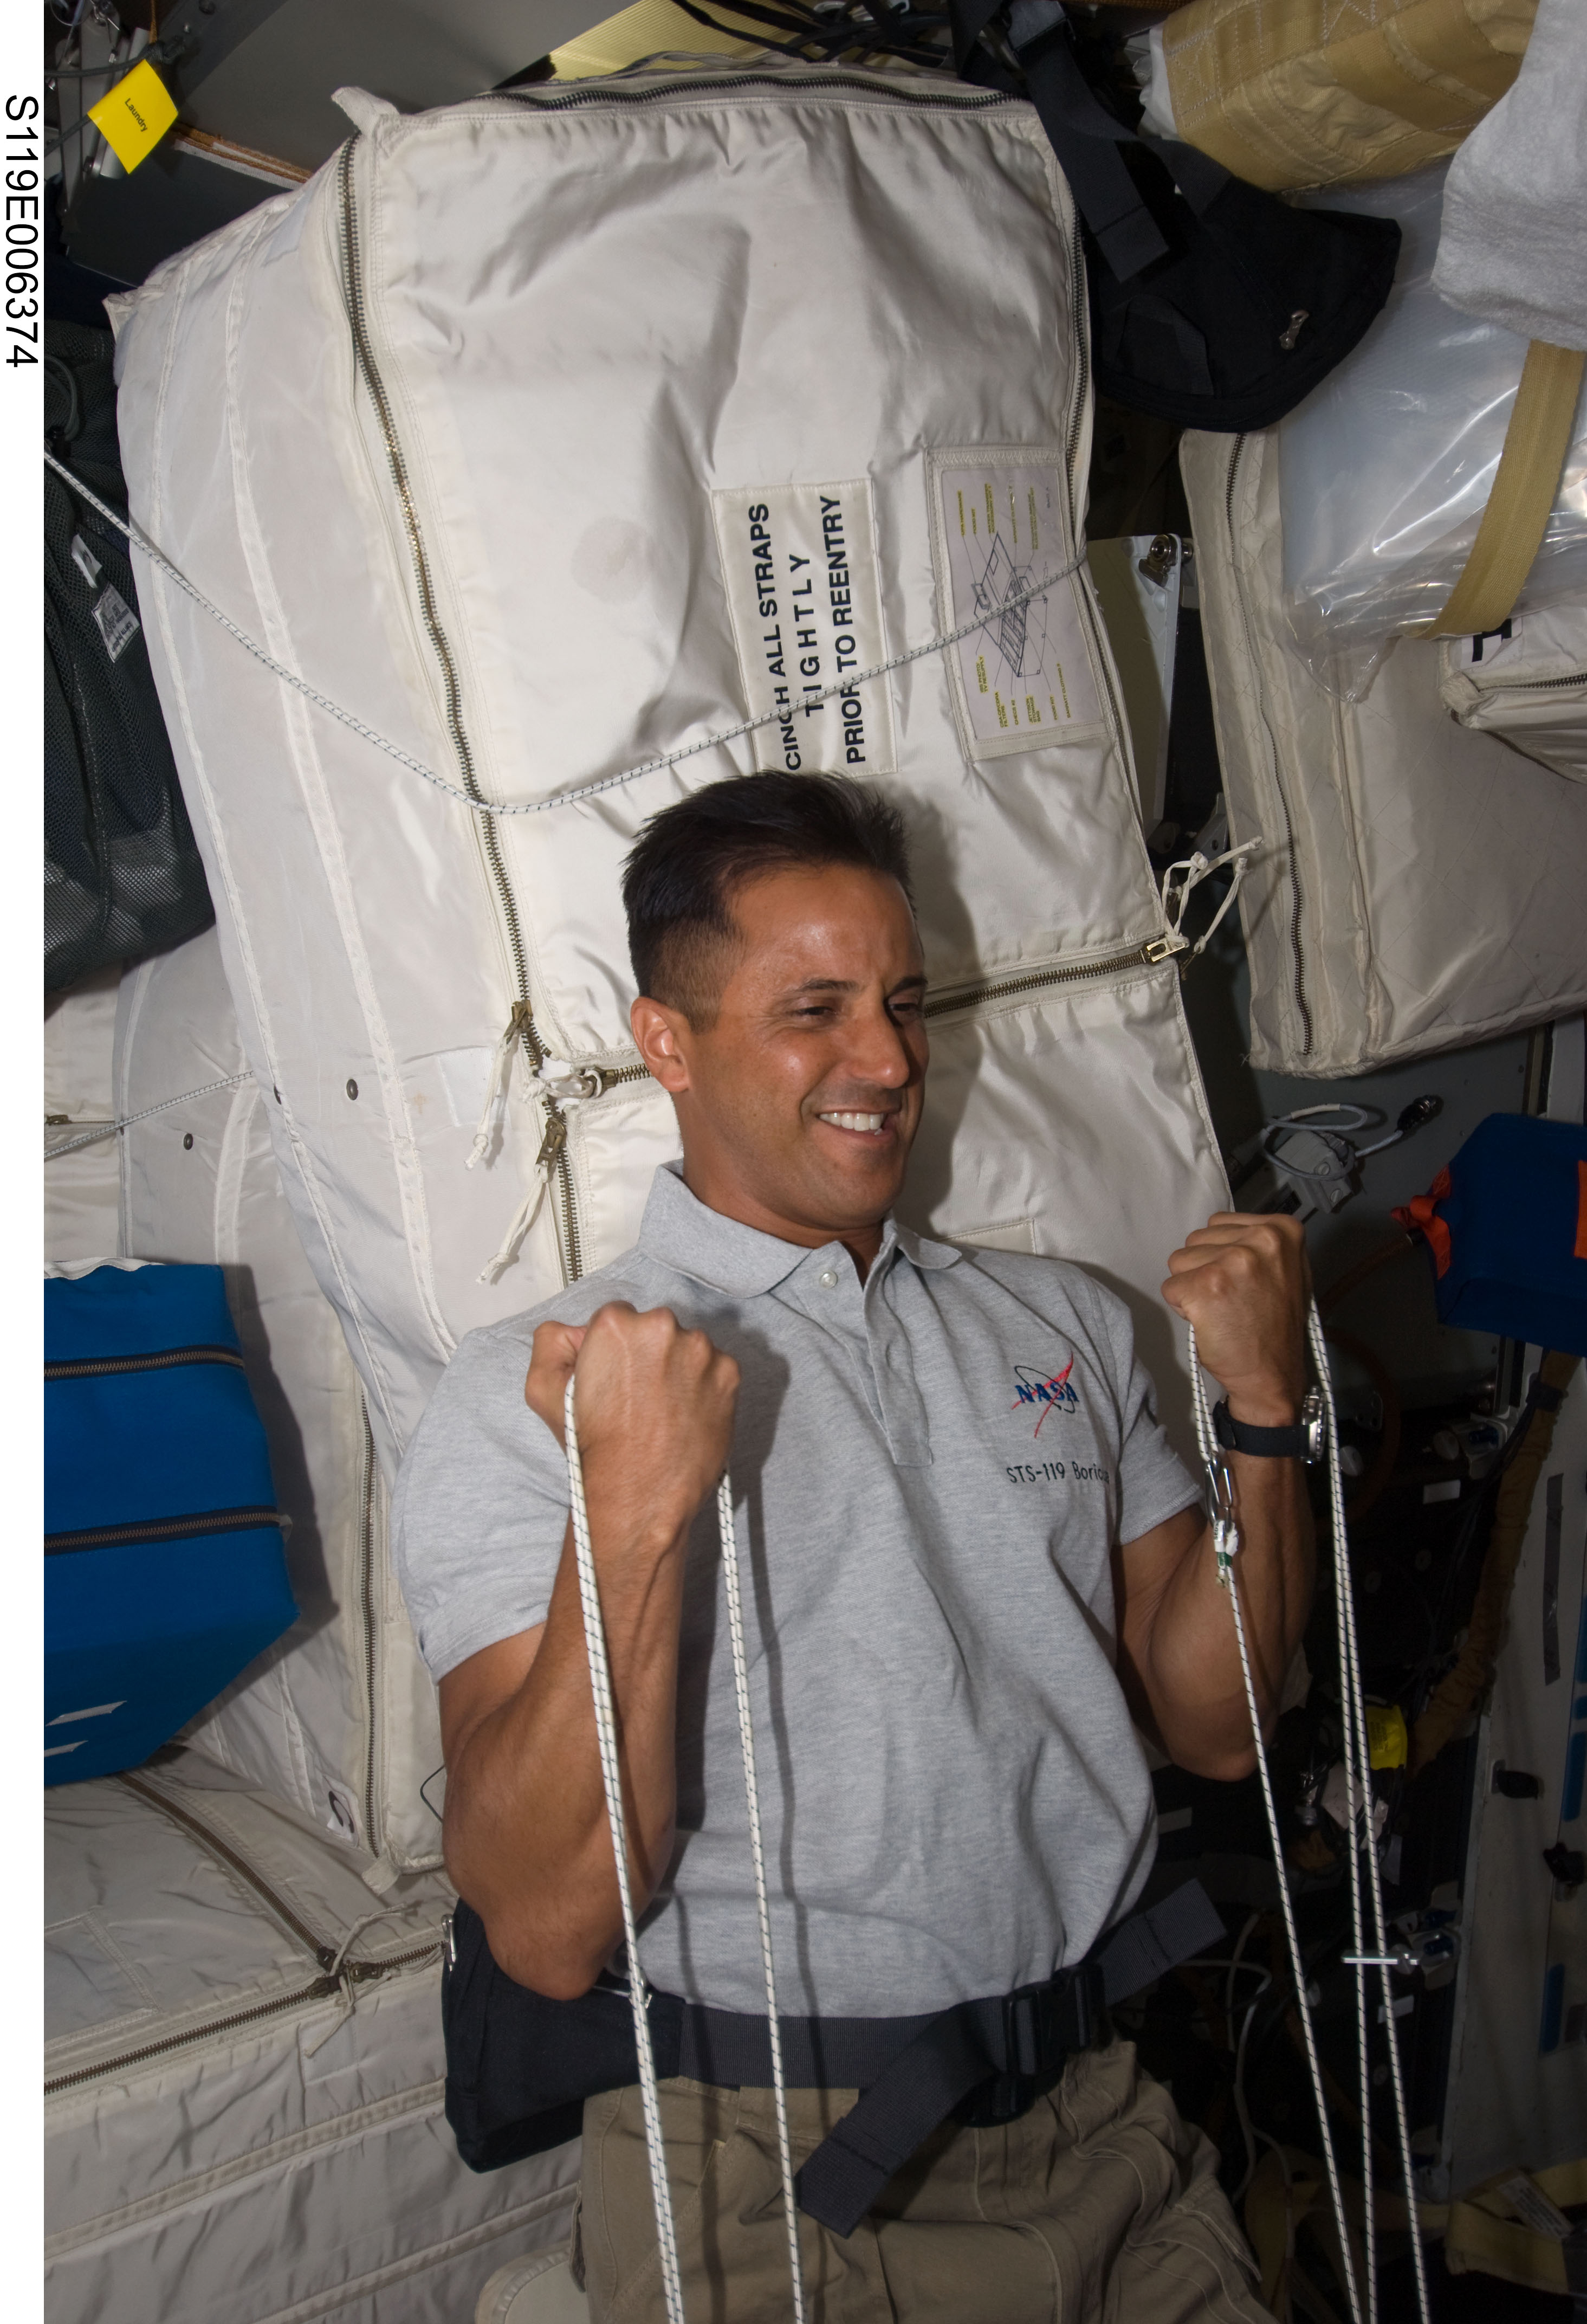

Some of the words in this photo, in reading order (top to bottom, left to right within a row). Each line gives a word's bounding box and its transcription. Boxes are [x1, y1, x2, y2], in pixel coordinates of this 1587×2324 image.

[125, 98, 147, 132] Laundry
[748, 503, 778, 617] STRAPS
[820, 495, 853, 626] REENTRY
[763, 624, 786, 677] ALL
[835, 635, 857, 673] TO
[774, 686, 801, 771] CINCH
[839, 683, 866, 764] PRIOR
[1015, 1382, 1080, 1404] NASA
[1006, 1461, 1066, 1483] STS-119
